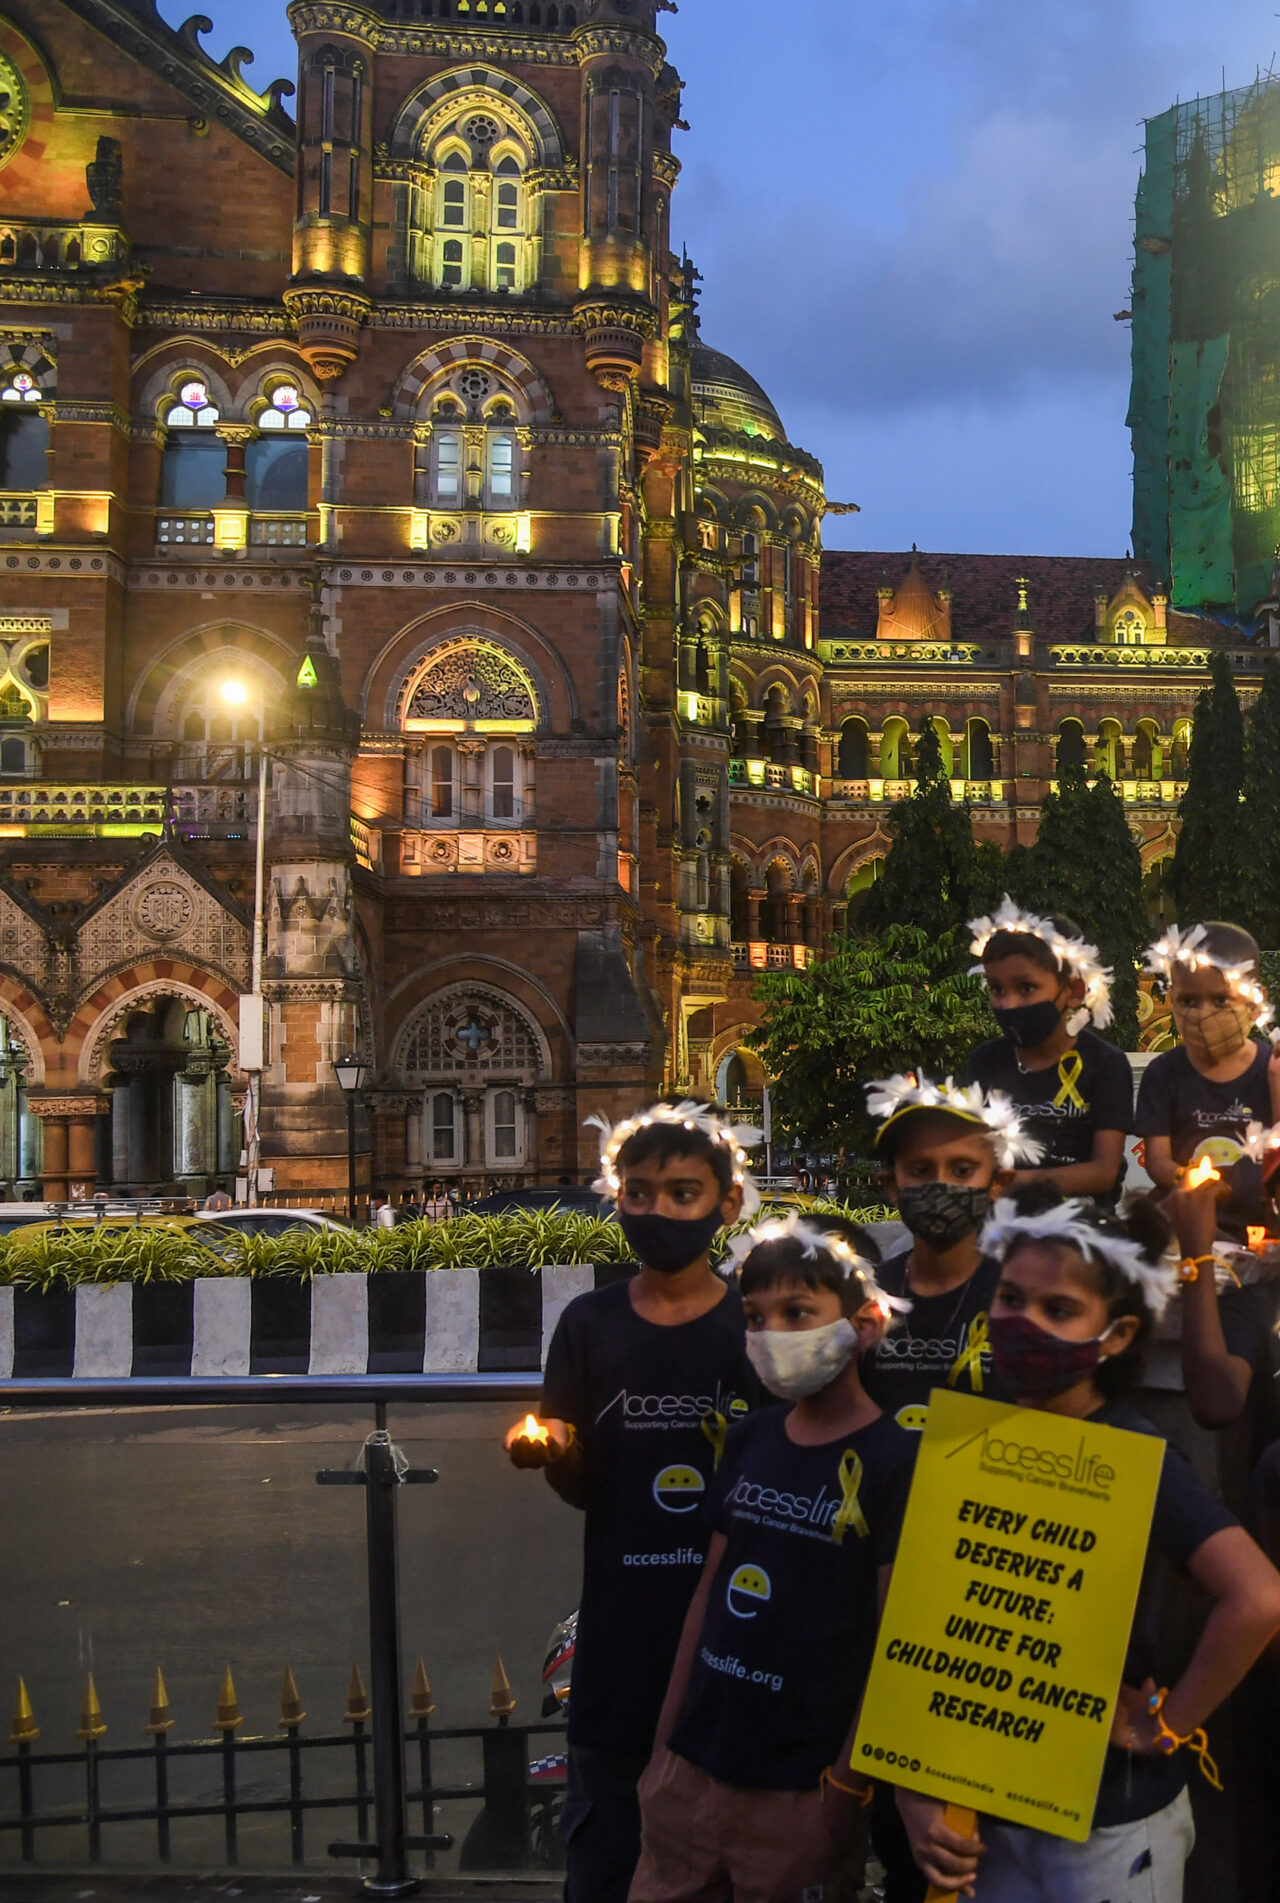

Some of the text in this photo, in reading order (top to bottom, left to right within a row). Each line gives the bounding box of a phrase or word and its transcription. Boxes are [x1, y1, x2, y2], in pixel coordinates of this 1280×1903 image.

[945, 1428, 1115, 1488] Accesslife
[957, 1500, 1097, 1553] EVERY CHILD
[623, 1547, 703, 1565] accesslife
[955, 1537, 1085, 1592] DESERVES A
[965, 1580, 1055, 1624] FUTURE:
[944, 1614, 1062, 1668] UNITE FOR
[886, 1638, 1107, 1723] CHILDHOOD CANCER
[928, 1690, 1045, 1743] RESEARCH
[1006, 1791, 1081, 1821] accesslife.org
